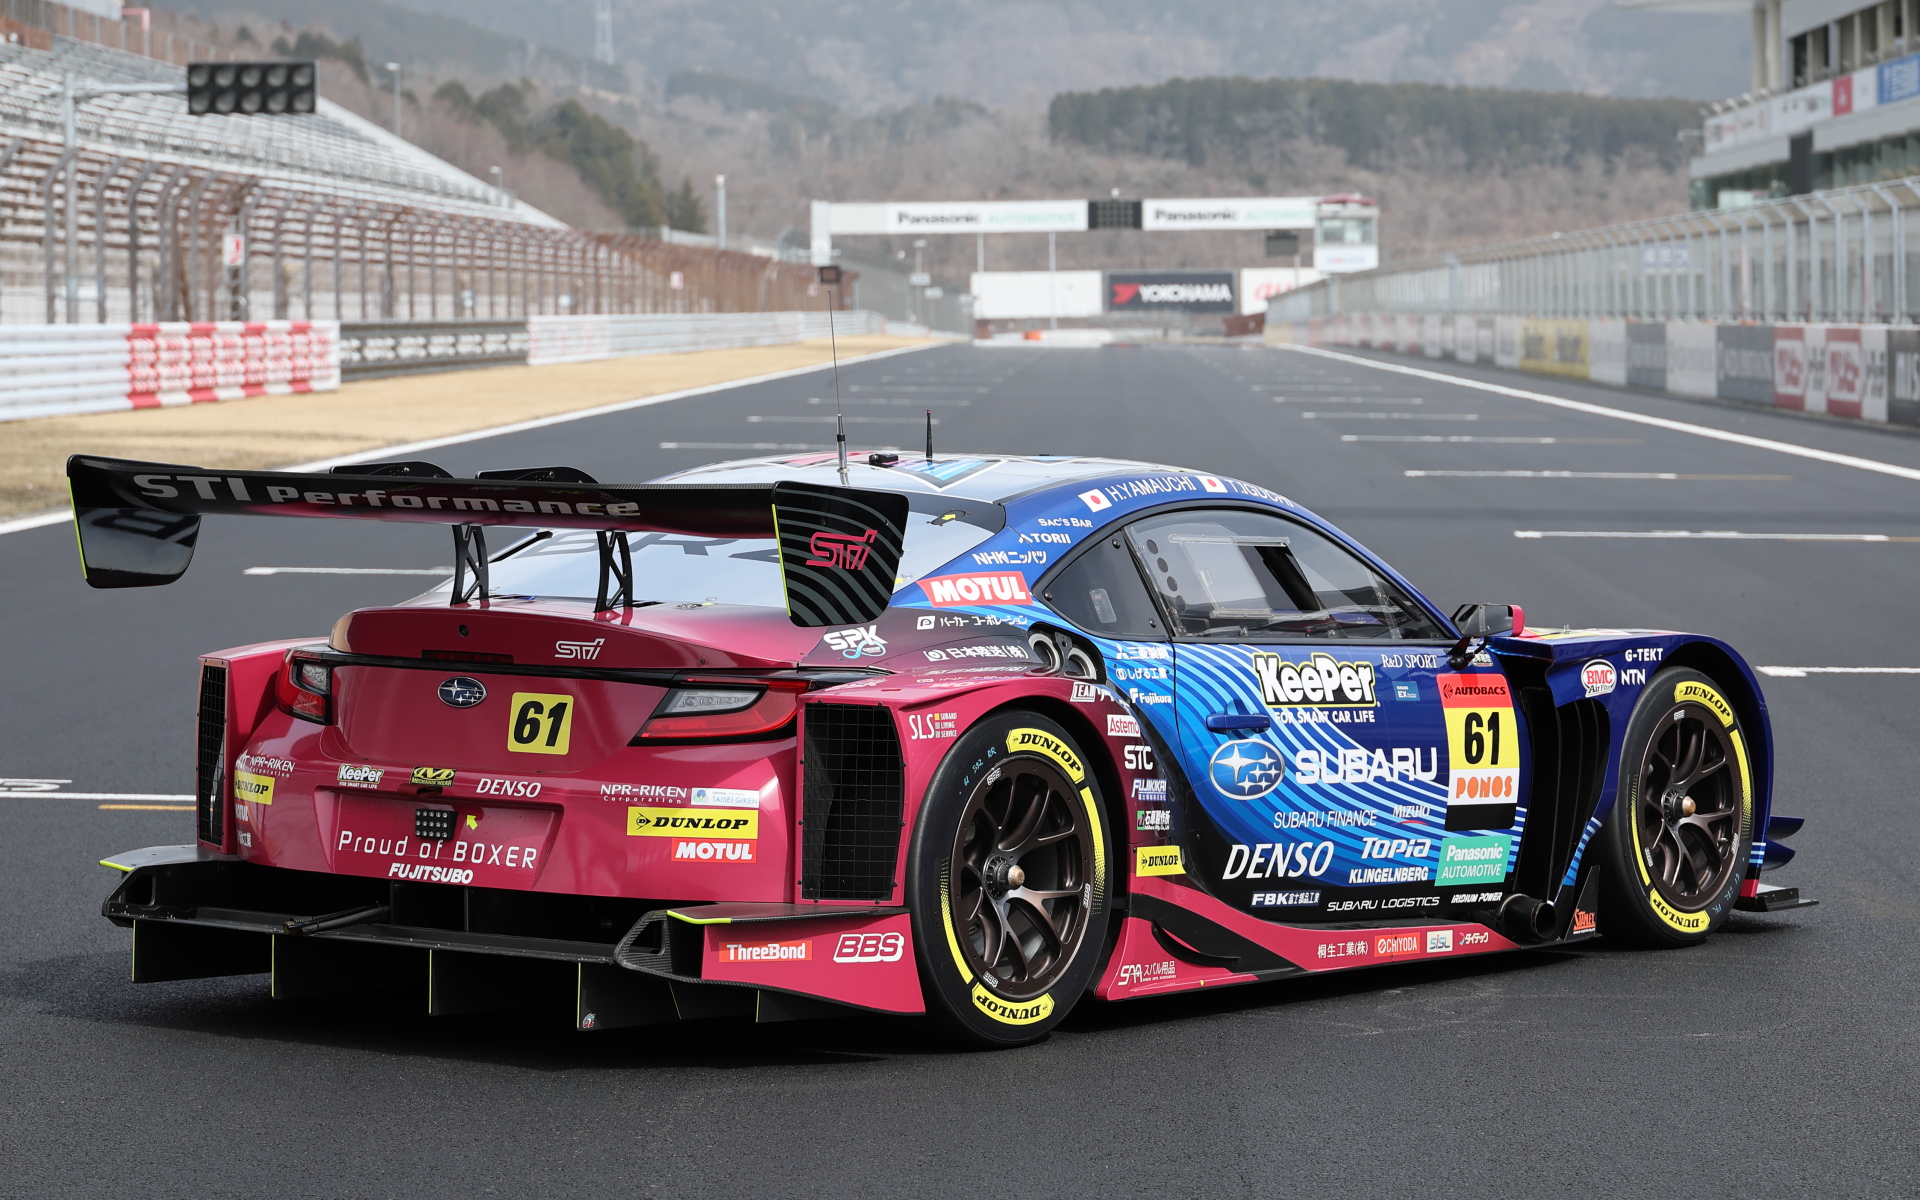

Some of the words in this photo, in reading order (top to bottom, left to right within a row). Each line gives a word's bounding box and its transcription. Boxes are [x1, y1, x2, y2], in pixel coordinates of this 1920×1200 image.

[898, 210, 981, 224] Panasonic
[1155, 208, 1237, 222] Panasonic
[1139, 282, 1232, 303] YOKOHAMA
[132, 473, 253, 501] STI
[1105, 475, 1197, 502] H.YAMAUCHI
[931, 576, 1027, 601] MOTUL
[823, 624, 888, 650] SPK
[1380, 654, 1403, 668] R&D
[1404, 654, 1438, 668] SPORT
[1625, 648, 1663, 662] G-TEKT
[1254, 655, 1375, 703] KeePer
[1586, 669, 1612, 685] BMC
[1621, 669, 1645, 685] NTN
[1139, 691, 1172, 705] Fujikura
[1454, 686, 1506, 695] AUTOBACS
[1683, 686, 1731, 718] DUNLOP
[513, 700, 569, 748] 61
[909, 713, 935, 740] SLS
[1274, 713, 1295, 724] FOR
[1298, 711, 1330, 723] SMART
[1332, 711, 1352, 723] CAR
[1354, 710, 1375, 722] LIFE
[1464, 711, 1500, 765] 61
[1019, 733, 1082, 772] DUNLOP
[1124, 744, 1154, 770] STC
[250, 756, 296, 772] NPR-RIKEN
[340, 764, 383, 783] KeePer
[1295, 747, 1438, 785] SUBARU
[476, 778, 542, 798] DENSO
[600, 784, 688, 799] NPR-RIKEN
[1456, 775, 1513, 799] PONOS
[603, 796, 682, 804] Corporation
[712, 796, 734, 804] TAISEI
[735, 796, 758, 805] GIKEN
[1273, 811, 1325, 829] SUBARU
[1327, 809, 1377, 828] FINANCE
[1393, 805, 1430, 818] MIZUHO
[652, 816, 749, 830] DUNLOP
[338, 830, 409, 857] Proud
[420, 839, 444, 860] of
[453, 841, 537, 869] BOXER
[675, 841, 753, 860] MOTUL
[1446, 843, 1503, 862] Panasonic
[1148, 855, 1178, 867] DUNLOP
[1222, 841, 1334, 880] DENSO
[388, 862, 474, 884] FUJITSUBO
[1349, 866, 1429, 884] KLINGELNBERG
[1442, 863, 1502, 879] AUTOMOTIVE
[1252, 892, 1289, 906] FBK
[1326, 899, 1377, 911] SUBARU
[1380, 896, 1440, 909] LOGISTICS
[1451, 893, 1479, 904] IRIDIUM
[1478, 892, 1503, 902] POWER
[1653, 899, 1699, 928] DUNLOP
[726, 943, 806, 960] ThreeBond
[833, 932, 904, 963] BBS
[1317, 941, 1368, 959] 桐生工業(株)
[1386, 936, 1417, 953] CHIYODA
[976, 995, 1041, 1019] DUNLOP
